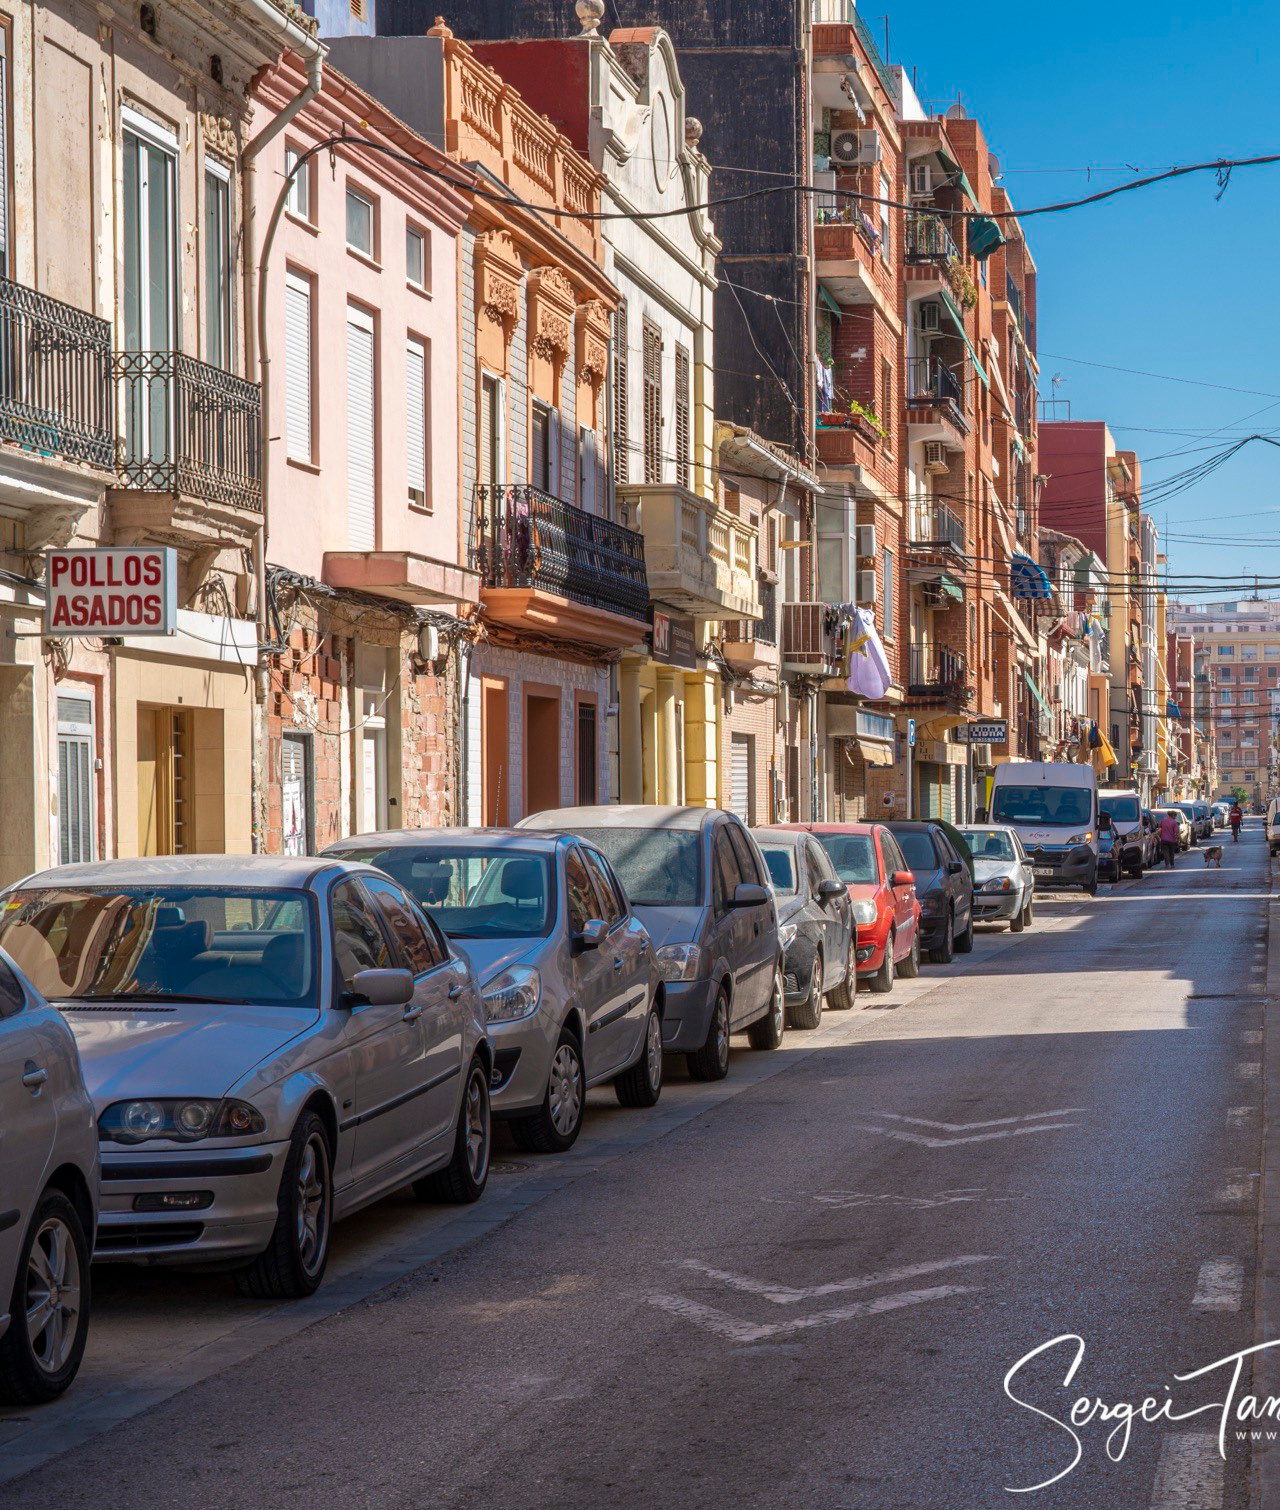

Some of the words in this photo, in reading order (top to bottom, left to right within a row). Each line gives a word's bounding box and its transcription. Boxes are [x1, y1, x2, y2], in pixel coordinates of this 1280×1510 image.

[52, 555, 161, 587] POLLOS
[52, 594, 161, 626] ASADOS
[654, 617, 669, 651] CNT
[972, 726, 1004, 737] LIBRA
